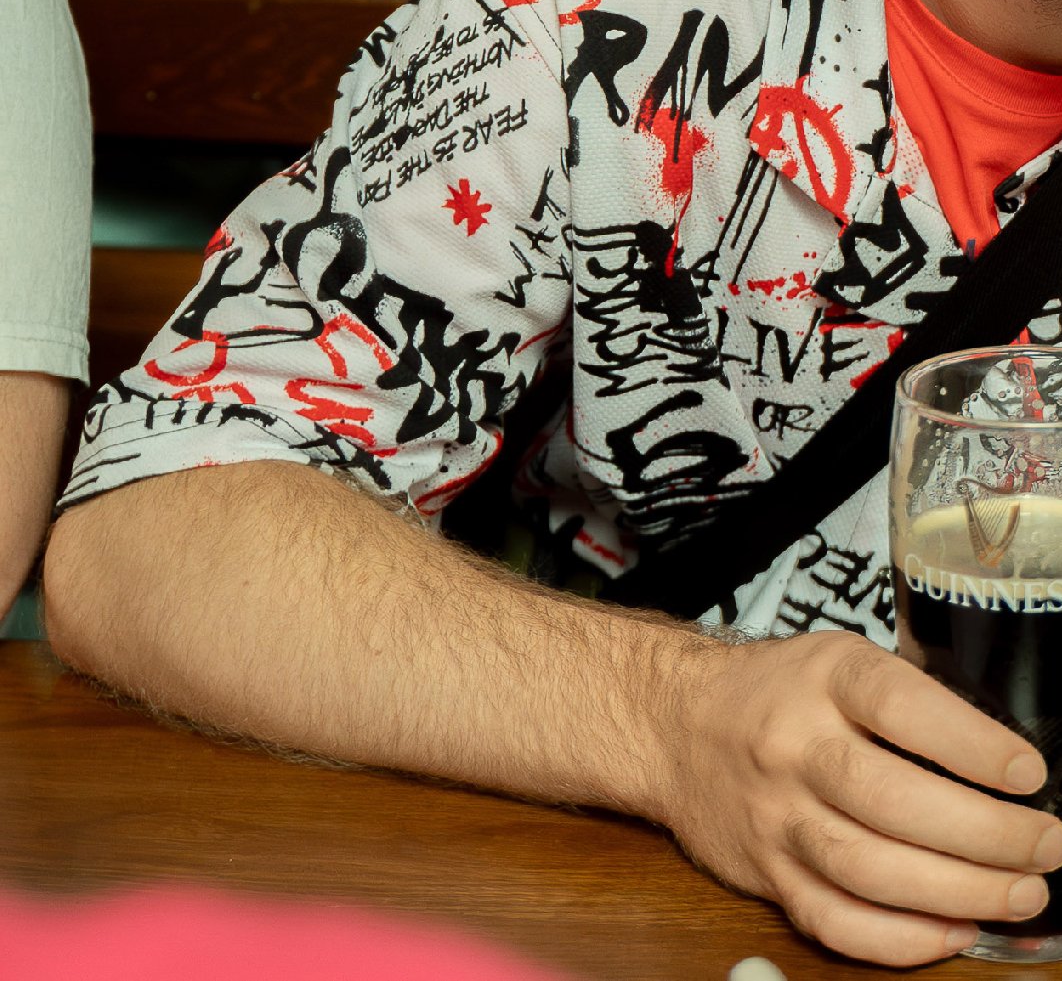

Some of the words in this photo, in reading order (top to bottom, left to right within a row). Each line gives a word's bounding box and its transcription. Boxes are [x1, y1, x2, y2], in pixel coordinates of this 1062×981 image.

[452, 81, 490, 117] THE
[463, 98, 529, 153] FEAR
[396, 149, 433, 188] THE
